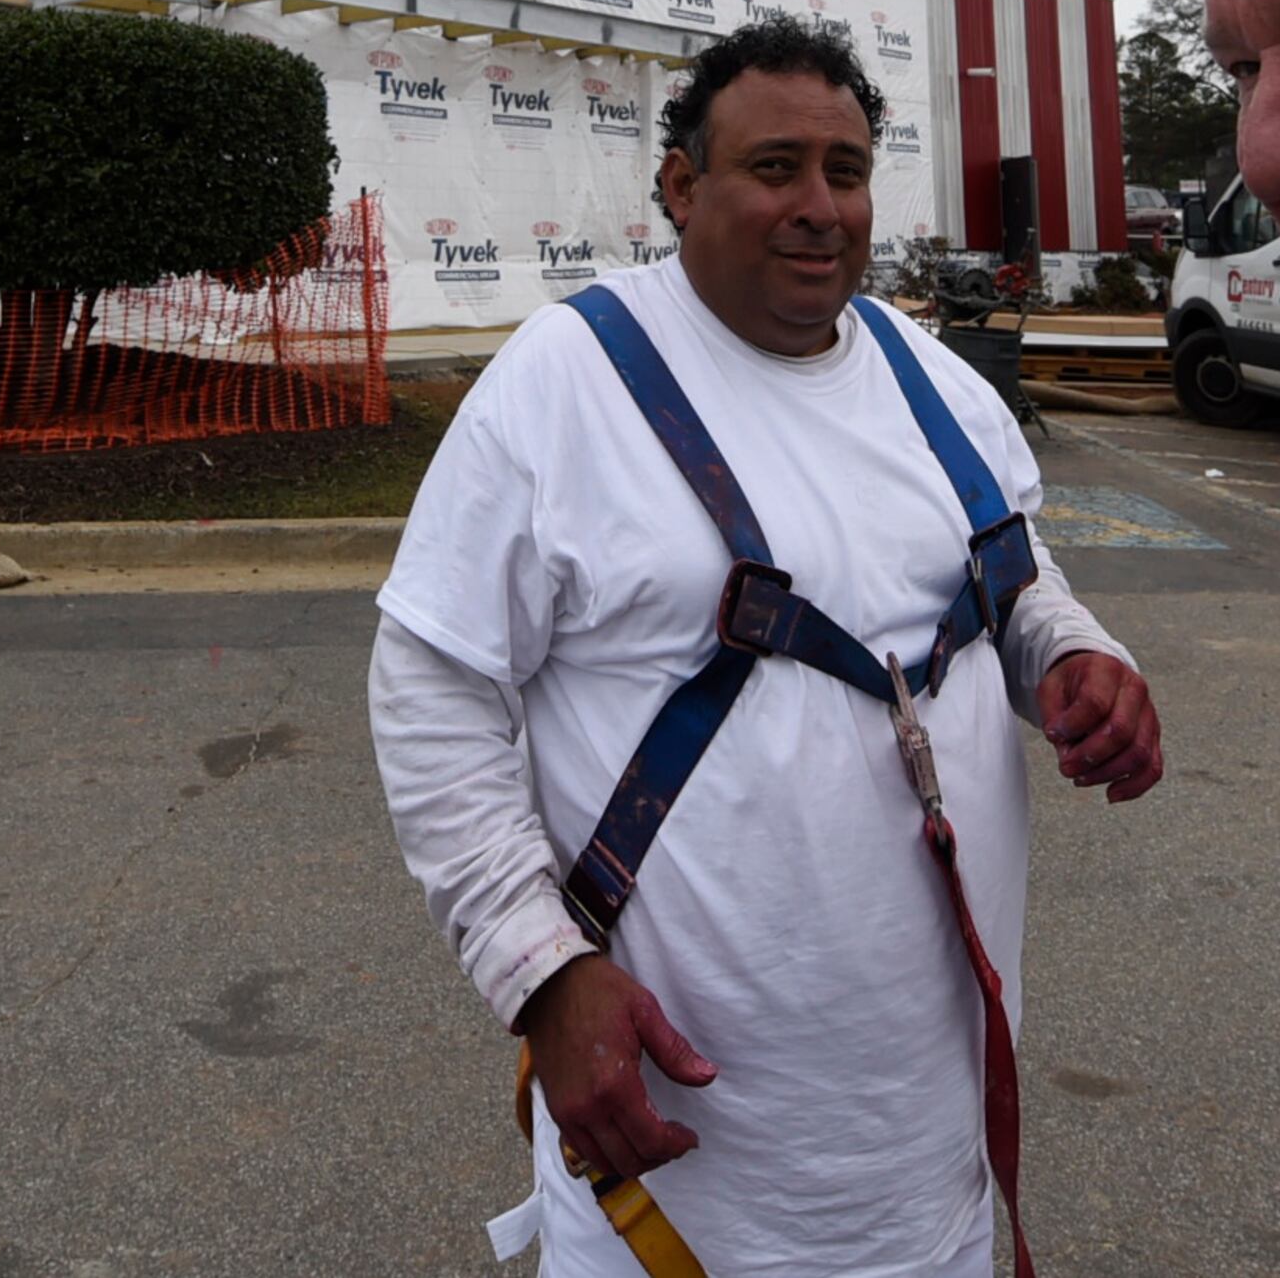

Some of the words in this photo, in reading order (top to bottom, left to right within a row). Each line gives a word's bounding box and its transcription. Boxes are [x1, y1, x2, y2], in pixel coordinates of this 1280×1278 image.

[875, 25, 911, 47] Tyvek
[374, 70, 447, 102] Tyvek
[489, 84, 551, 113] Tyvek
[884, 121, 919, 140] Tyvek
[323, 237, 386, 268] yvek
[432, 238, 499, 268] Tyvek
